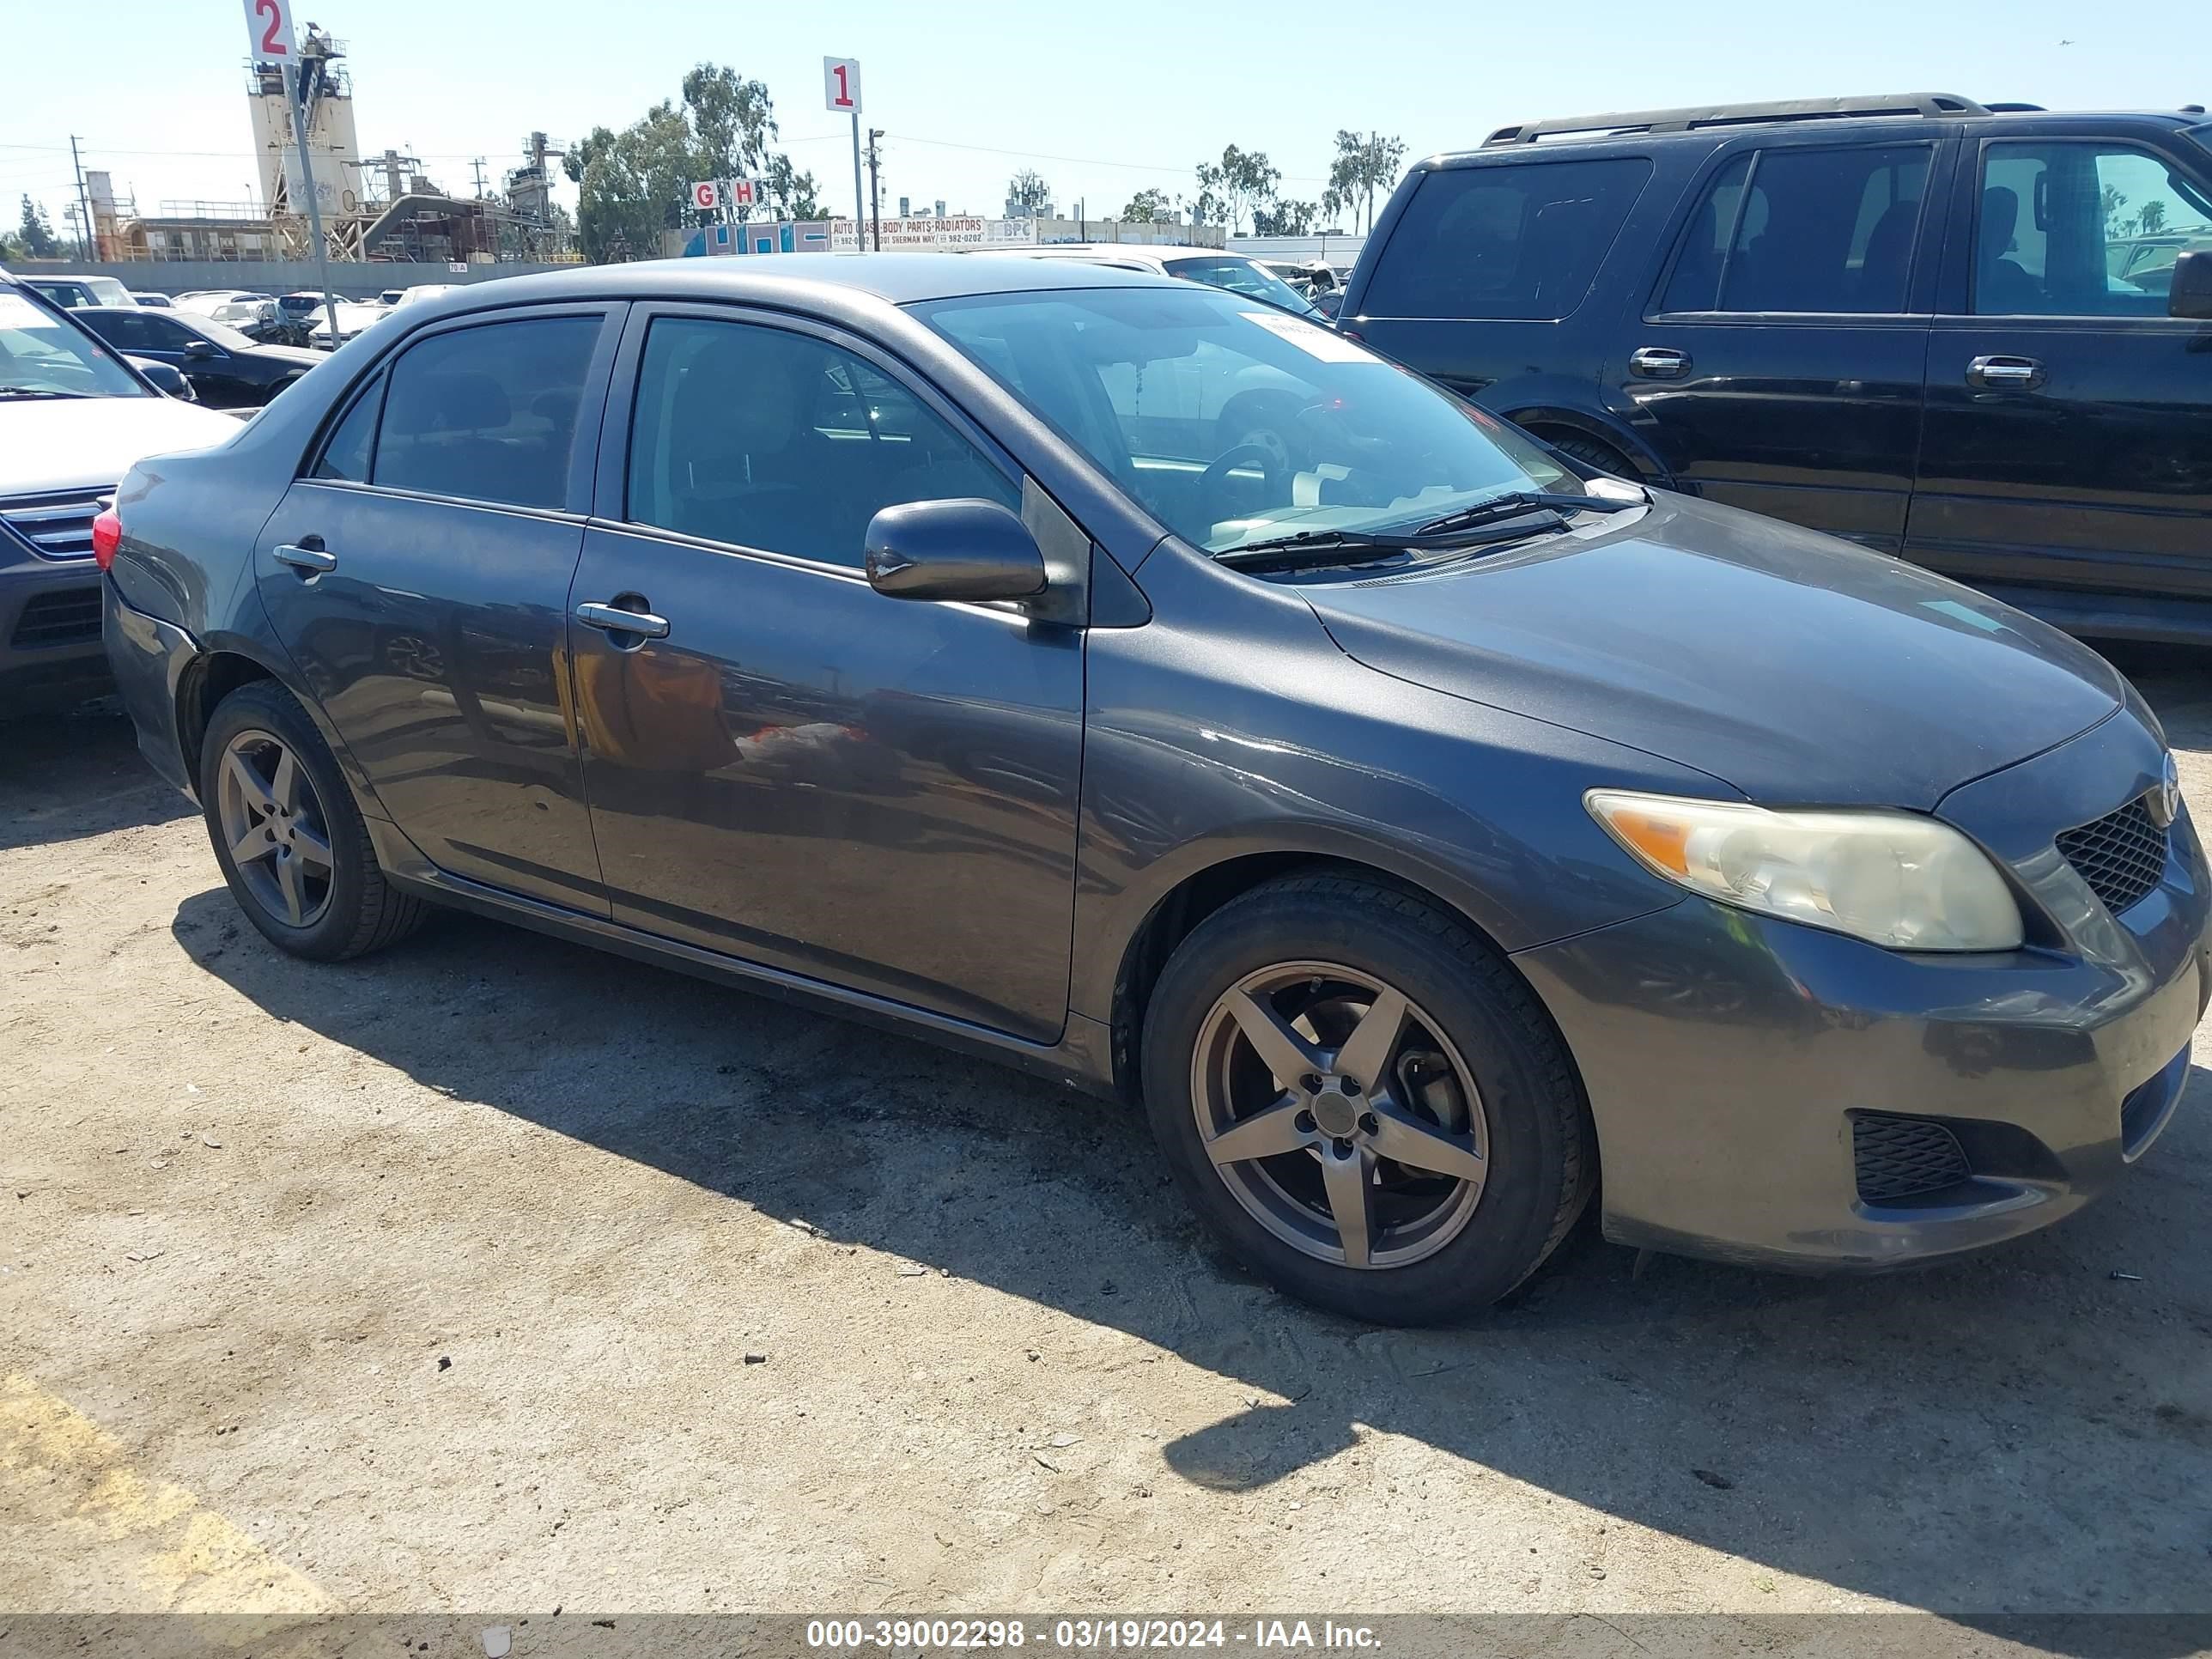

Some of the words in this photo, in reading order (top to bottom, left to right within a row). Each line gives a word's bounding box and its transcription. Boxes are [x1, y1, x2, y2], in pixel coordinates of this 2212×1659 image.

[256, 0, 287, 55] 2
[834, 65, 853, 106] 1
[696, 185, 714, 206] G
[736, 182, 752, 203] H
[834, 222, 853, 234] AUTO
[1004, 222, 1030, 236] BPC
[892, 235, 921, 244] SHERMAN
